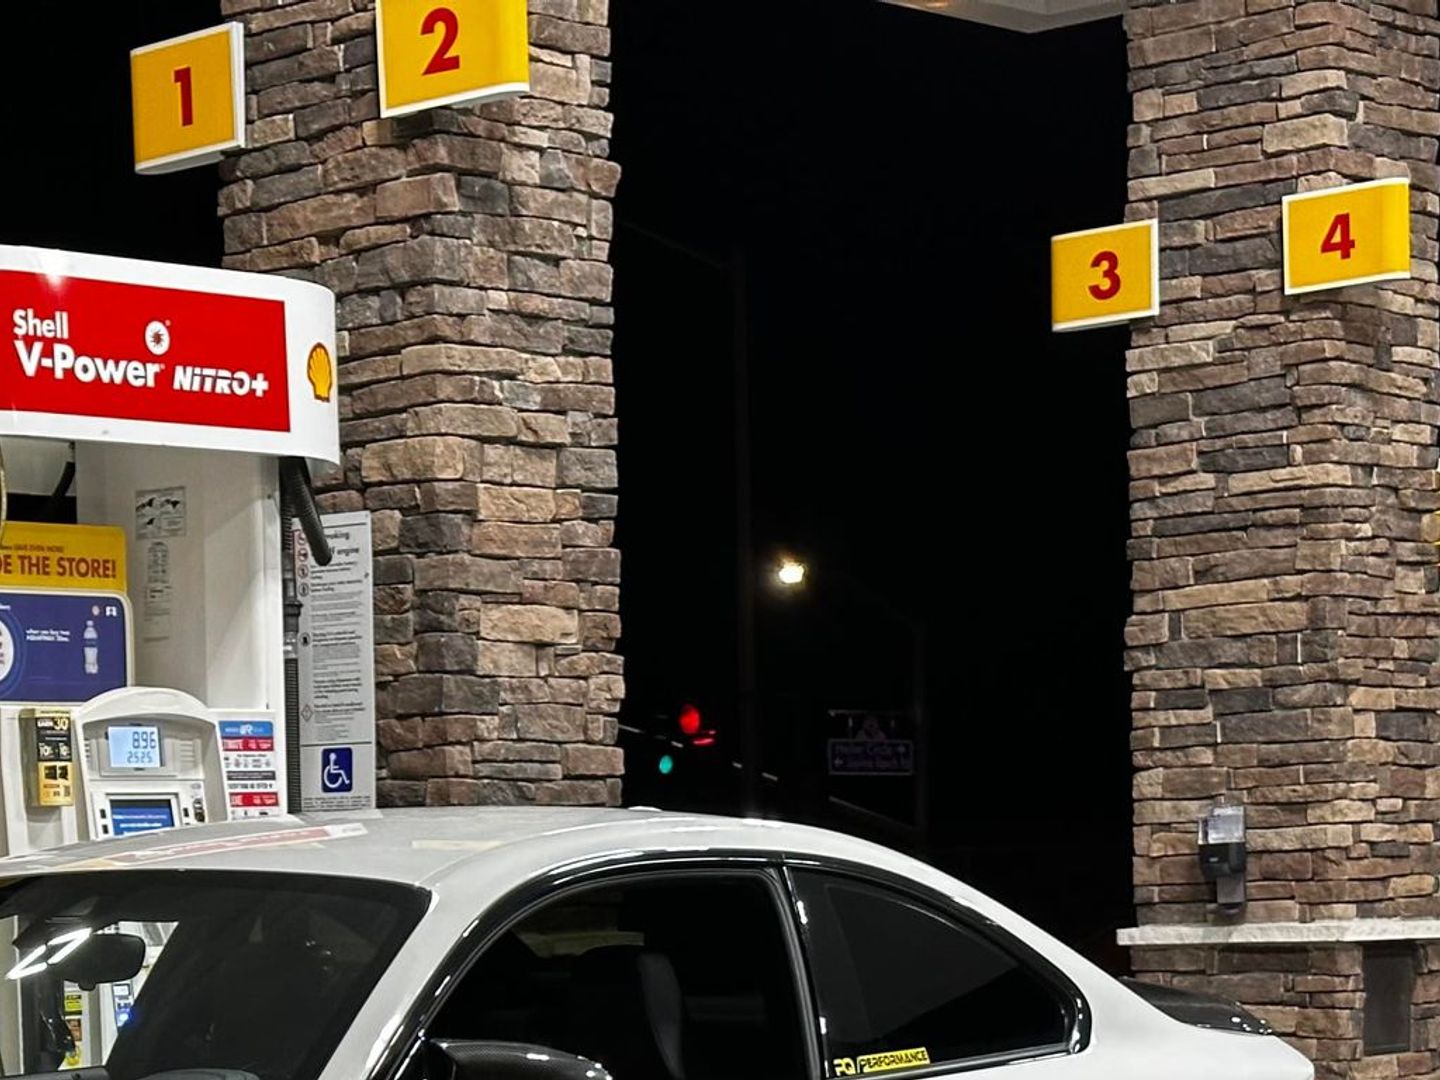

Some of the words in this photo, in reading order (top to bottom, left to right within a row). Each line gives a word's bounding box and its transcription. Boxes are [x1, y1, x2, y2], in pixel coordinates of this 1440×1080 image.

[420, 7, 460, 76] 2
[173, 66, 194, 127] 1
[1320, 212, 1356, 260] 4
[1088, 250, 1121, 300] 3
[13, 308, 69, 339] Shell
[14, 340, 161, 388] V-Power
[18, 555, 51, 576] THE
[56, 557, 117, 578] STORE!
[860, 1050, 927, 1071] PERFORMANCE
